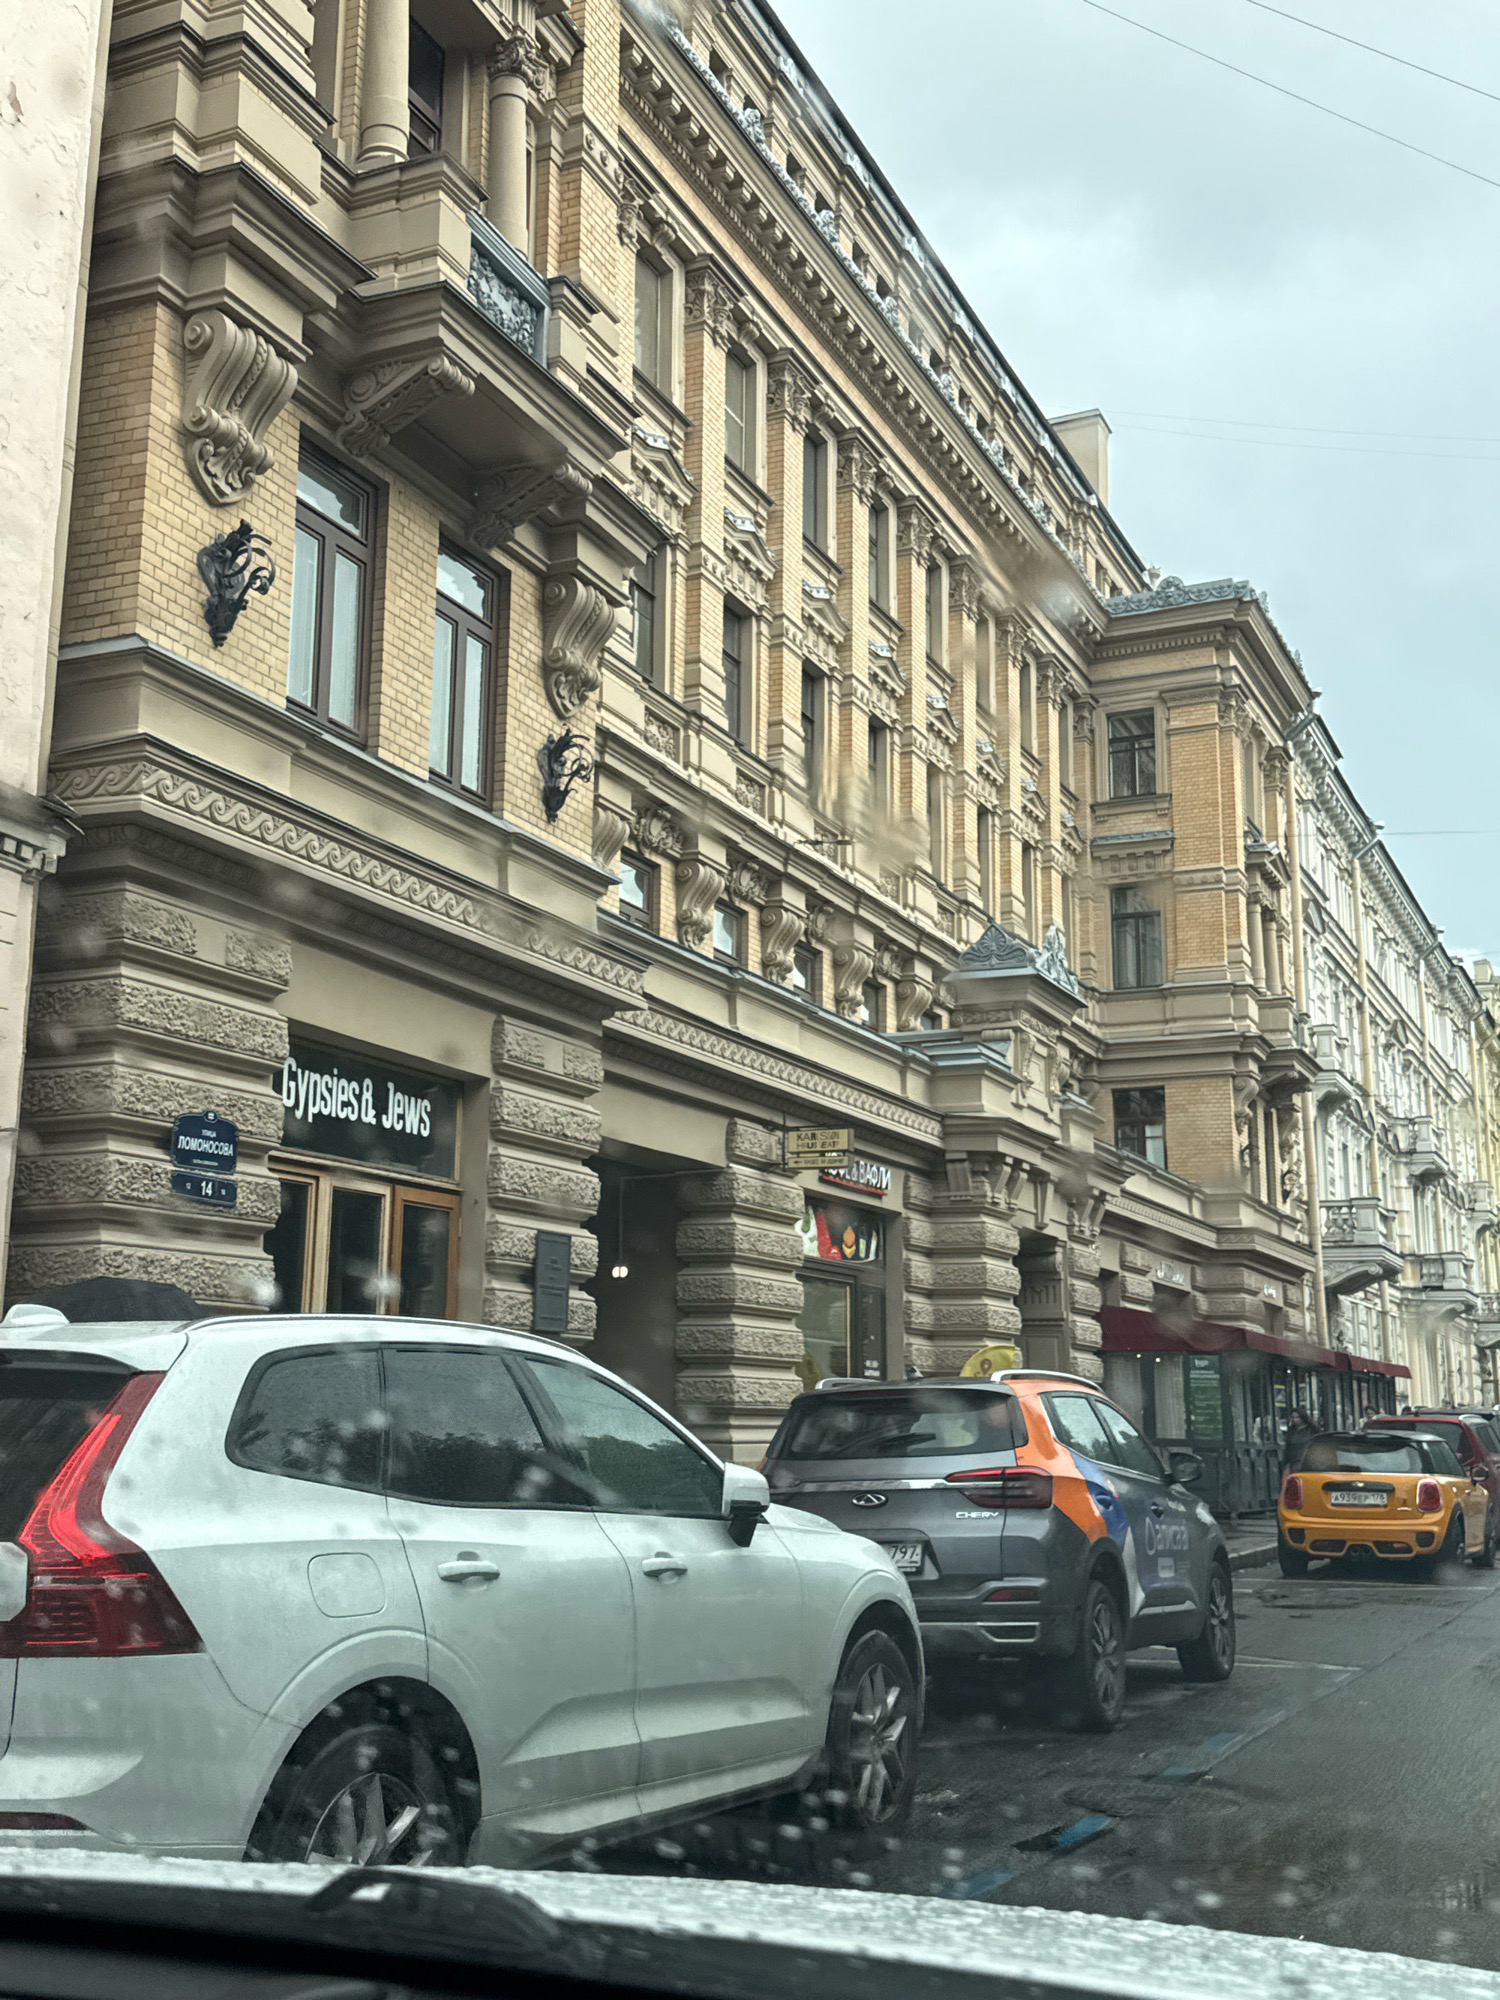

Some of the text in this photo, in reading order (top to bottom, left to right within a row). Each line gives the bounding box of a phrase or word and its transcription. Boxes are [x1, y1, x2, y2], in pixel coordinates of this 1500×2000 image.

[282, 1056, 431, 1138] Gypsies & Jews
[177, 1135, 234, 1157] ЛОМОНОСОВА
[859, 1160, 892, 1191] ВАФЛИ
[200, 1180, 213, 1197] 14
[955, 1511, 999, 1519] CHERY
[891, 1545, 916, 1559] 797
